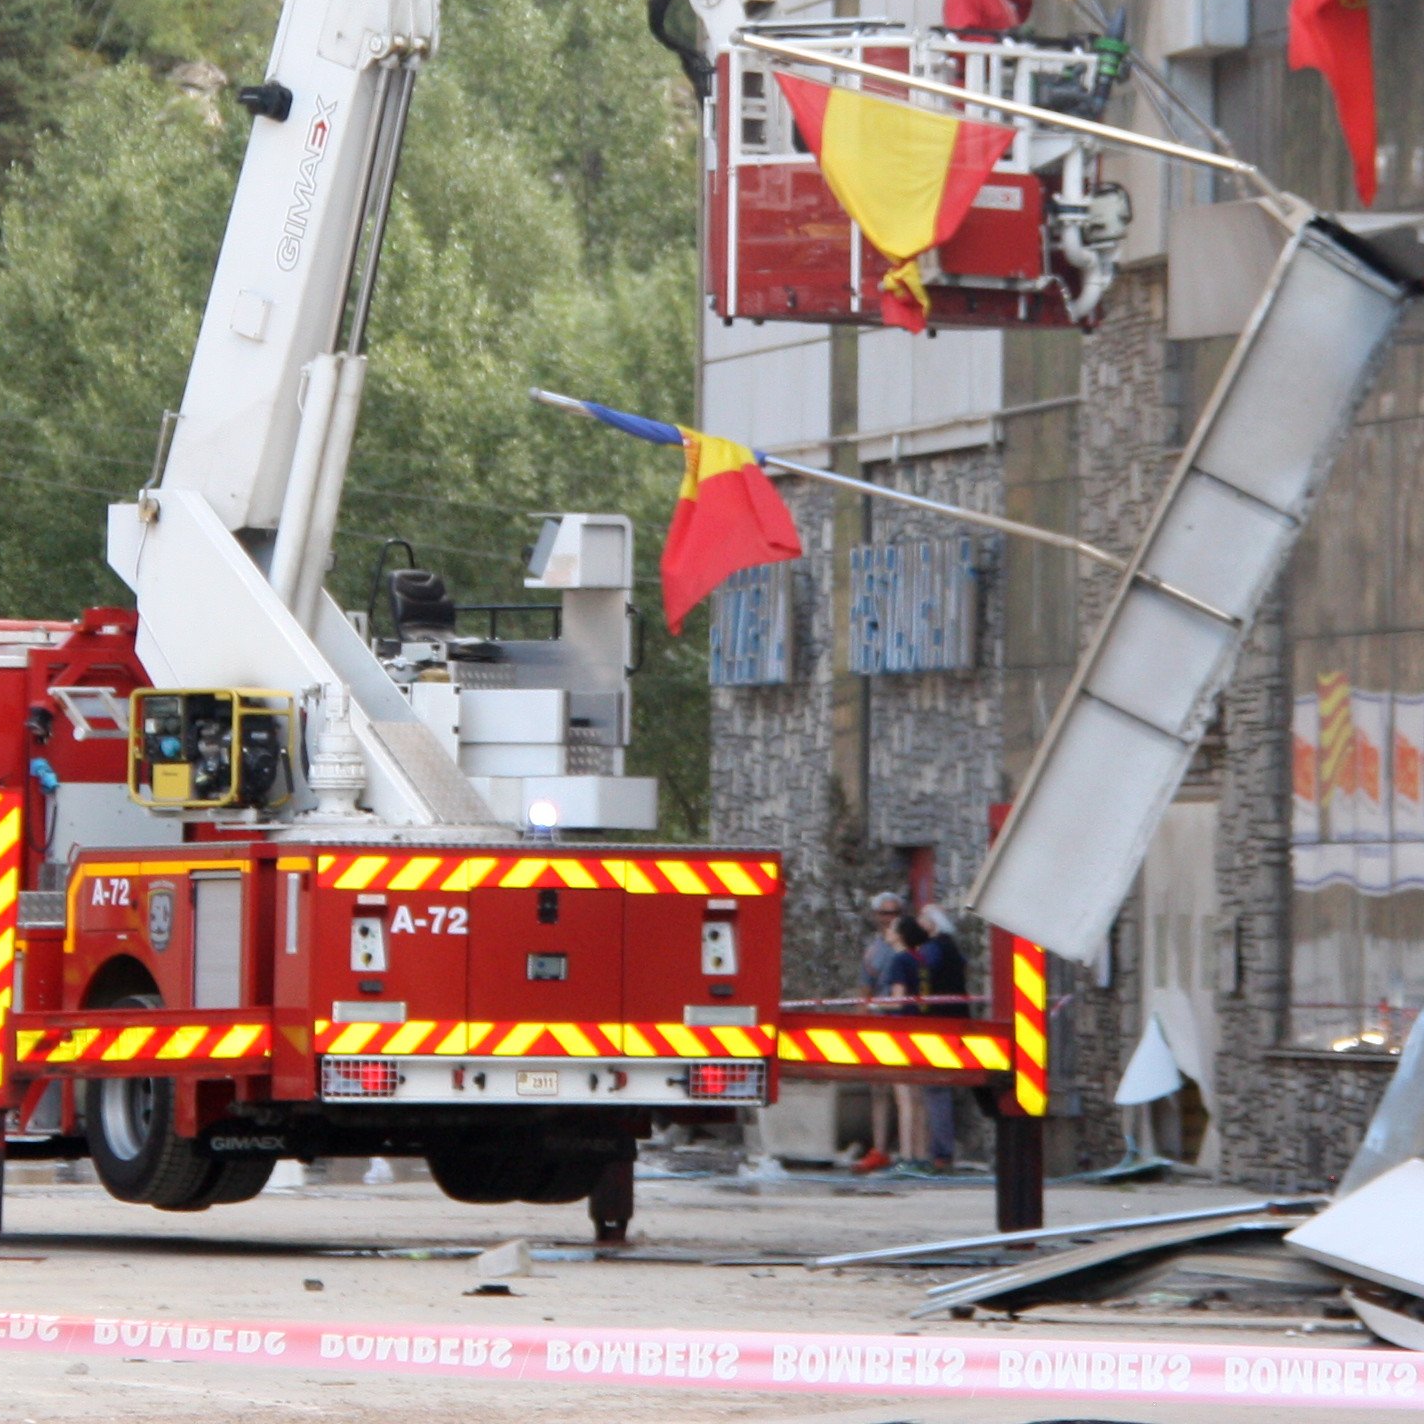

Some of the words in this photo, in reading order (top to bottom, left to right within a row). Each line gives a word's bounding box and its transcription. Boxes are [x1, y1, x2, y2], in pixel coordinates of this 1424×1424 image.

[276, 94, 338, 272] GIMAEX
[92, 878, 130, 906] A-72
[390, 905, 469, 935] A-72
[210, 1136, 285, 1152] GIMAEX
